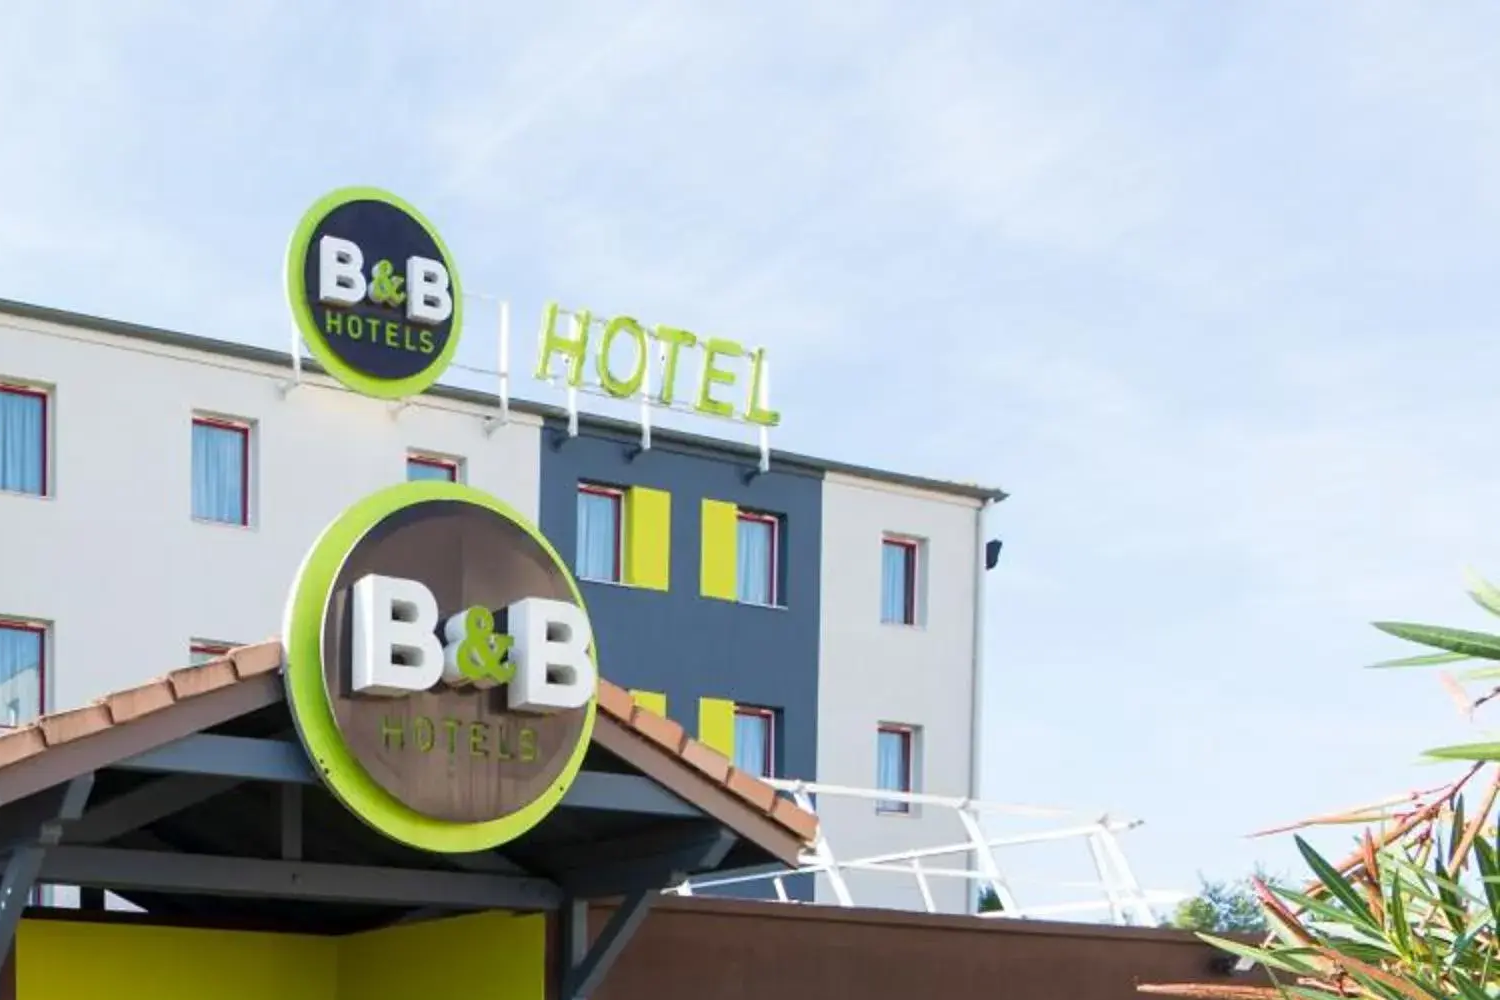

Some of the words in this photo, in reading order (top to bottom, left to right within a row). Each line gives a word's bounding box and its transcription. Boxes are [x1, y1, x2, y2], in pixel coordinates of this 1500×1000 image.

[319, 235, 452, 324] B&B
[325, 310, 434, 354] HOTELS
[535, 302, 780, 427] HOTEL
[352, 573, 596, 712] B&B
[381, 716, 540, 763] HOTELS
